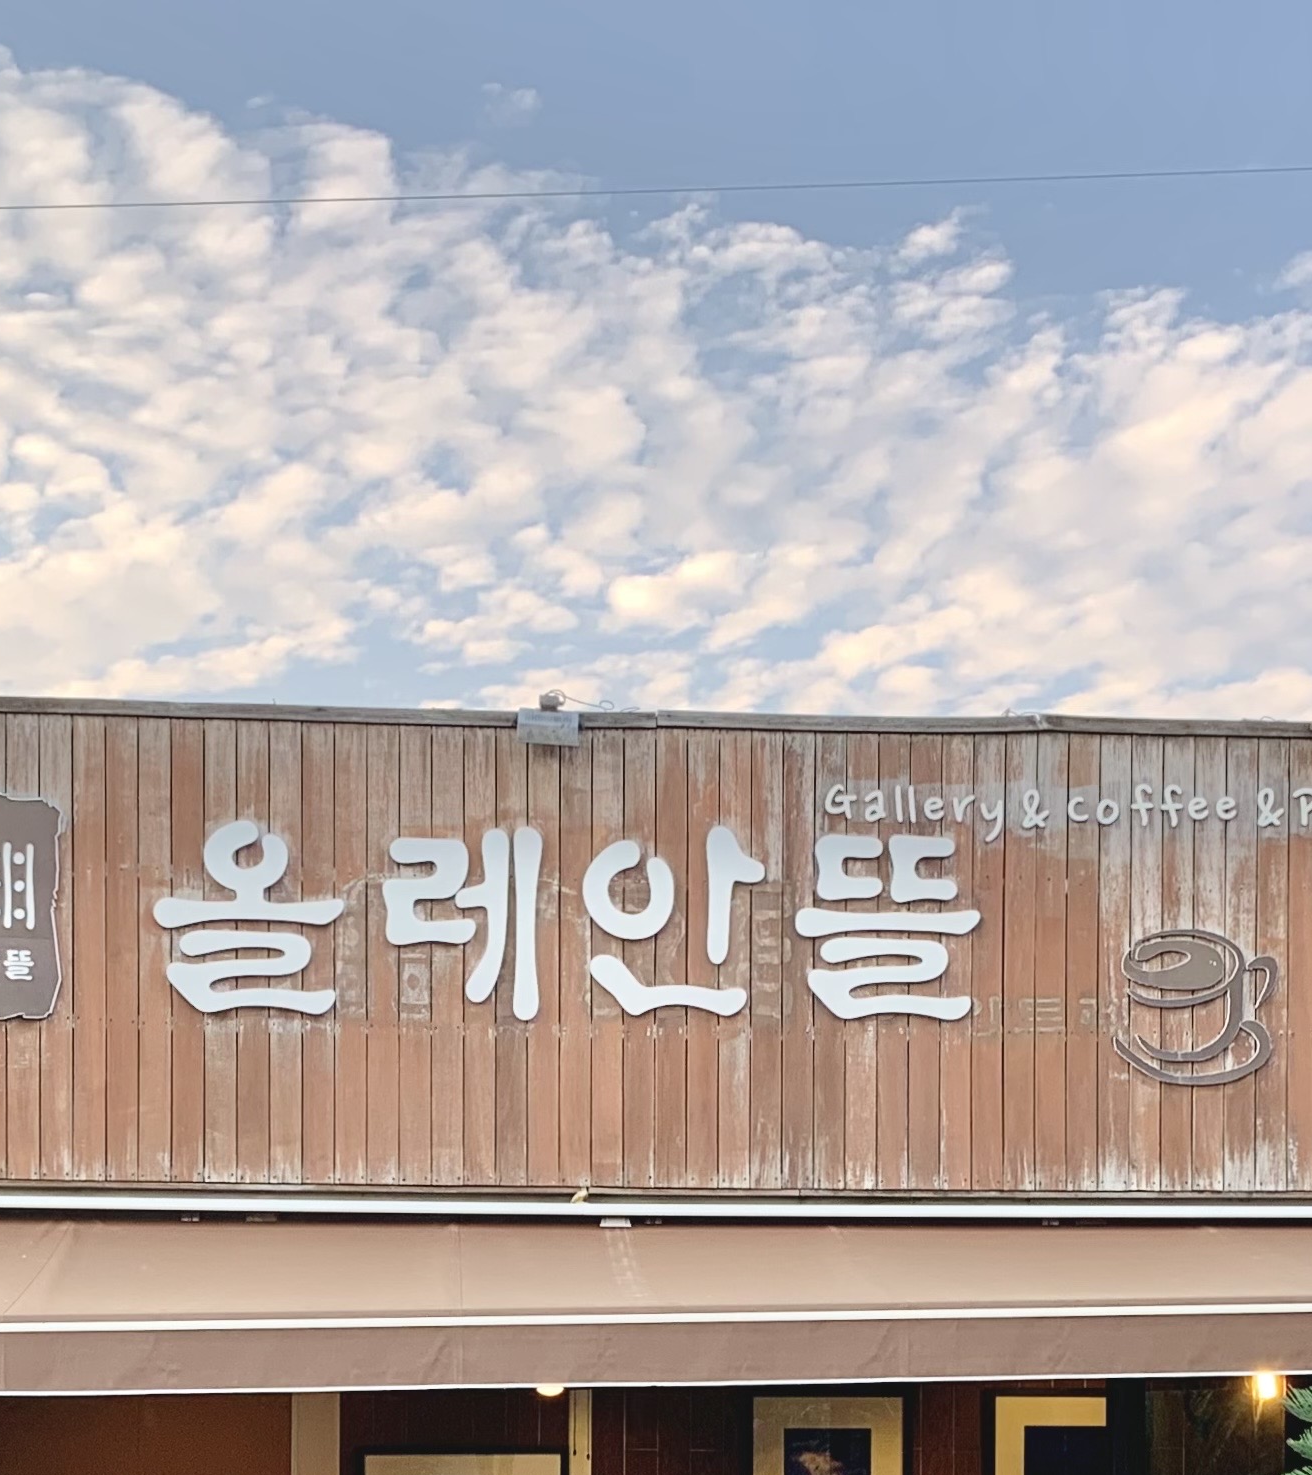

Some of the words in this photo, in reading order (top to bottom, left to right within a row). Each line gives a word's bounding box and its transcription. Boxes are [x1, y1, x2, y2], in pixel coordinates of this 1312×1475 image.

[824, 783, 1004, 842] Gallery
[1067, 784, 1237, 828] coffee
[153, 819, 982, 1021] 올레안뜰
